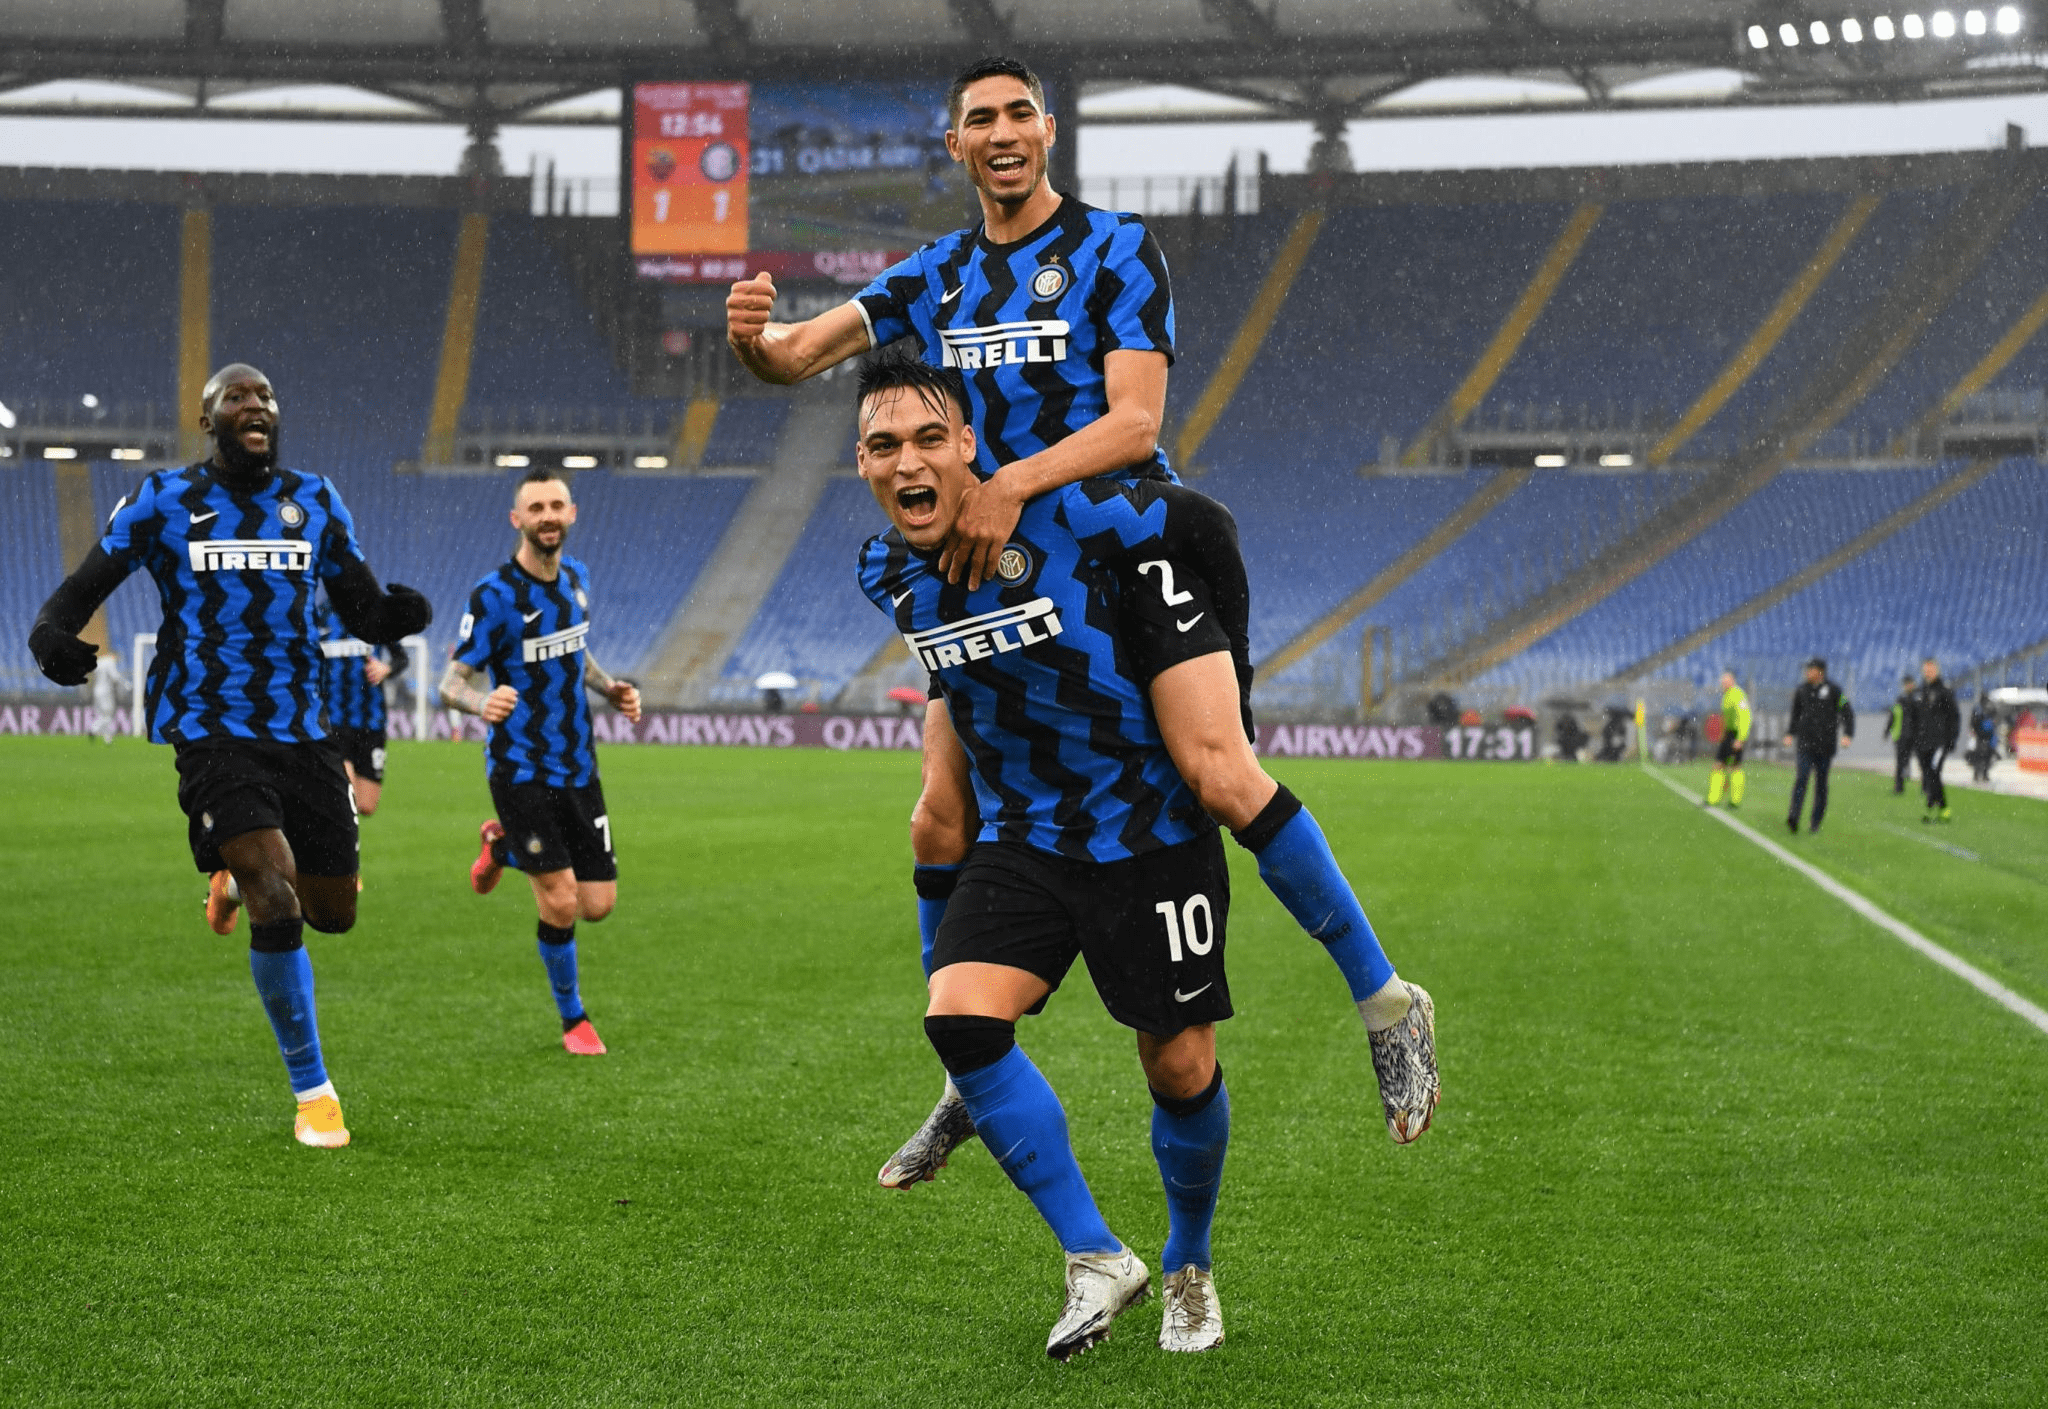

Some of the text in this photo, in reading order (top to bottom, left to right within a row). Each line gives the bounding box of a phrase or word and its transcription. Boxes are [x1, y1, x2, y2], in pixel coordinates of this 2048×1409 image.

[653, 190, 731, 222] 1 1
[188, 540, 312, 571] PIRELLI
[1137, 559, 1194, 607] 2
[903, 597, 1063, 671] PIRELLI
[645, 714, 795, 746] AIRWAYS
[822, 715, 924, 749] QATA
[1269, 725, 1532, 760] AIRWAYS 17:31
[1155, 893, 1214, 962] 10
